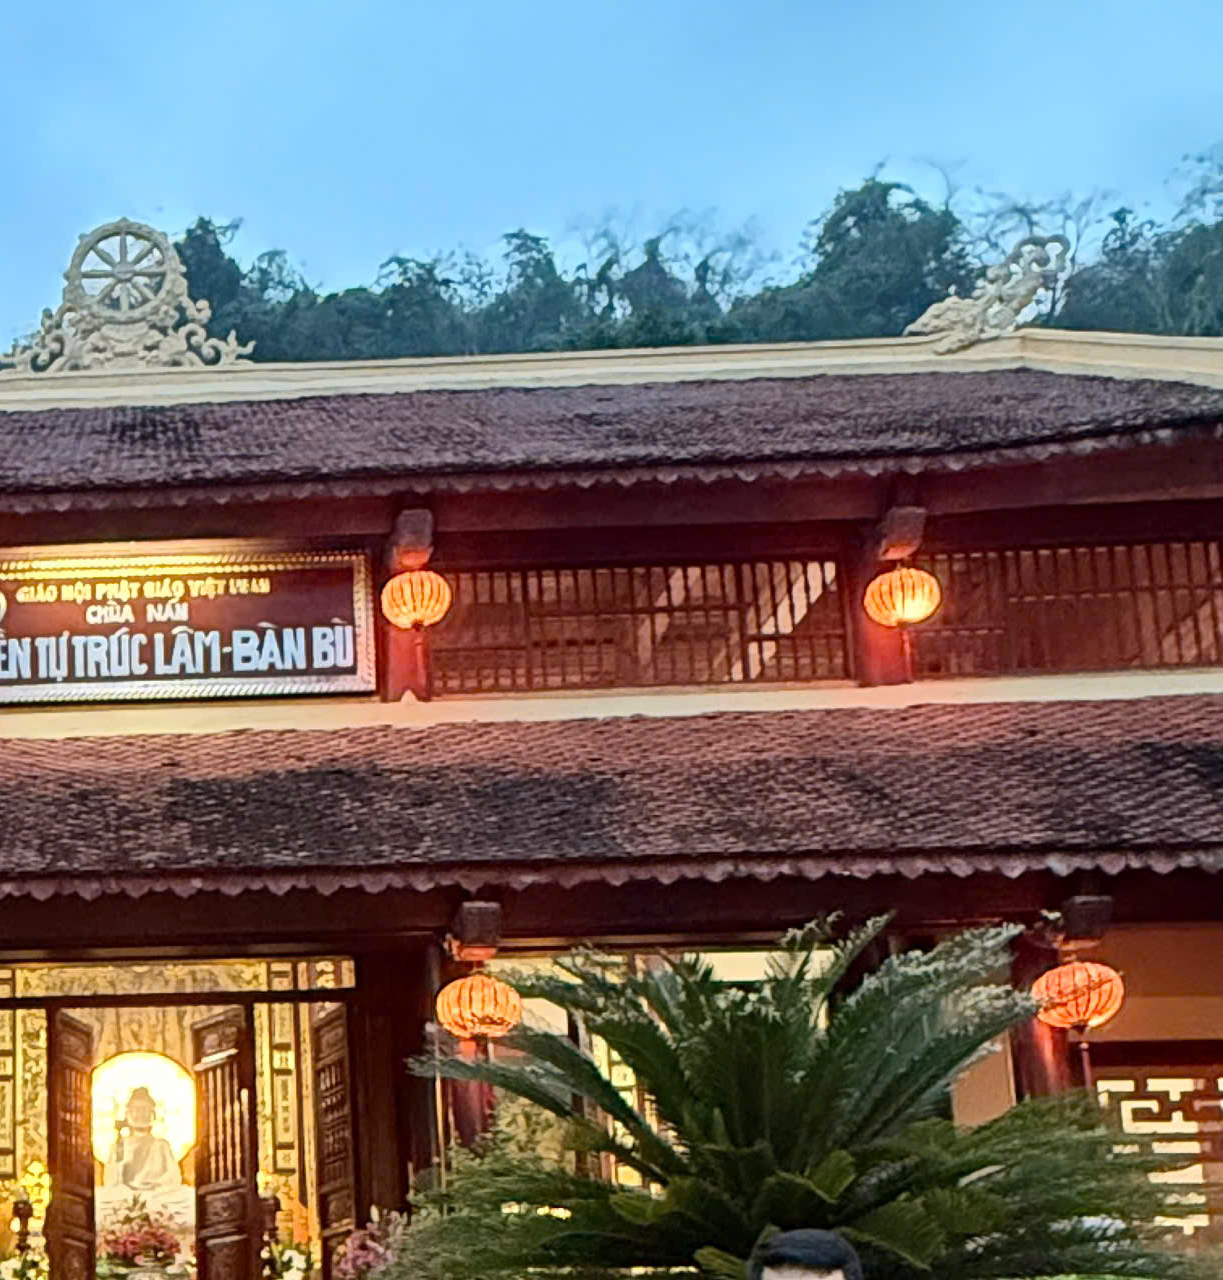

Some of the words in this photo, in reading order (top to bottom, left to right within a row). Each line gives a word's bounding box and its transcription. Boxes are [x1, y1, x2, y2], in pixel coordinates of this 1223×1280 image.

[95, 578, 141, 602] PHẬT
[187, 577, 227, 600] VIỆT
[86, 600, 135, 625] CHÙA
[34, 629, 69, 682] TỰ
[71, 626, 149, 678] TRÚC
[311, 616, 354, 669] BÙ
